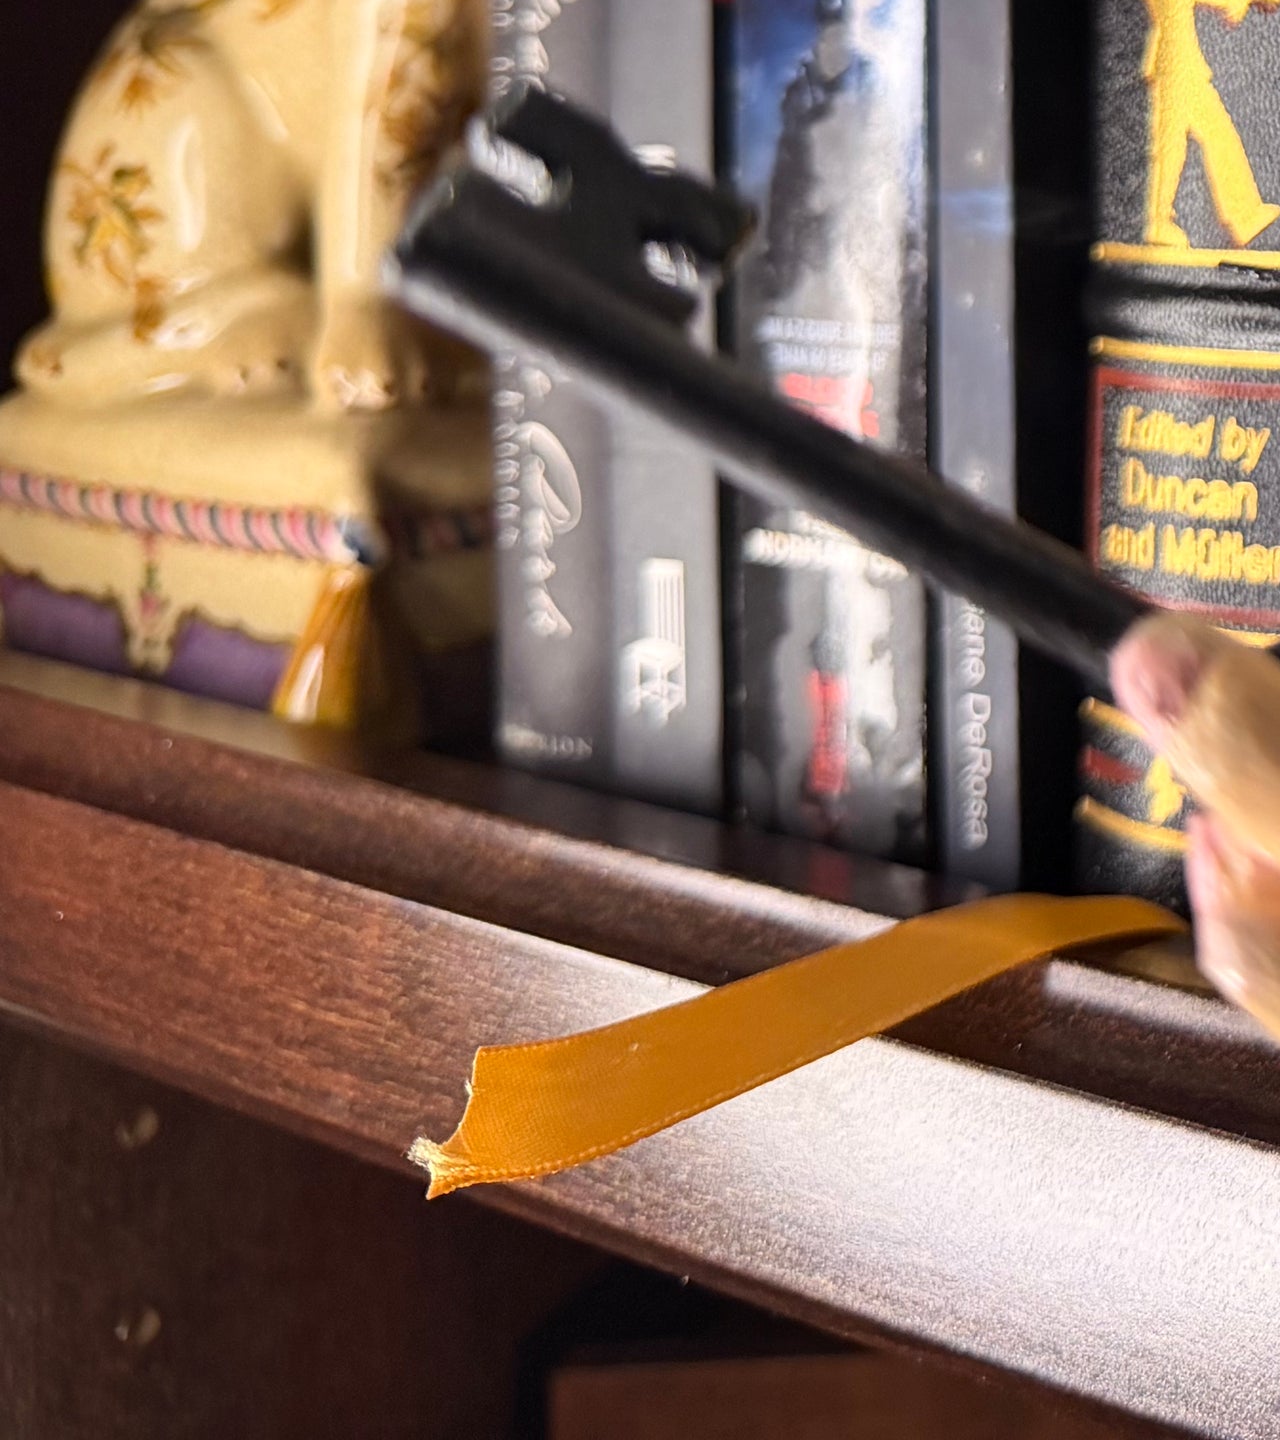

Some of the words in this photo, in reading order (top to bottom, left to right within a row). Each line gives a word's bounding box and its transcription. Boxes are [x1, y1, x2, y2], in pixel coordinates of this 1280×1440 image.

[1220, 416, 1271, 475] by
[1119, 457, 1259, 522] Duncan
[1101, 521, 1156, 572] and
[957, 692, 993, 851] DeRosa
